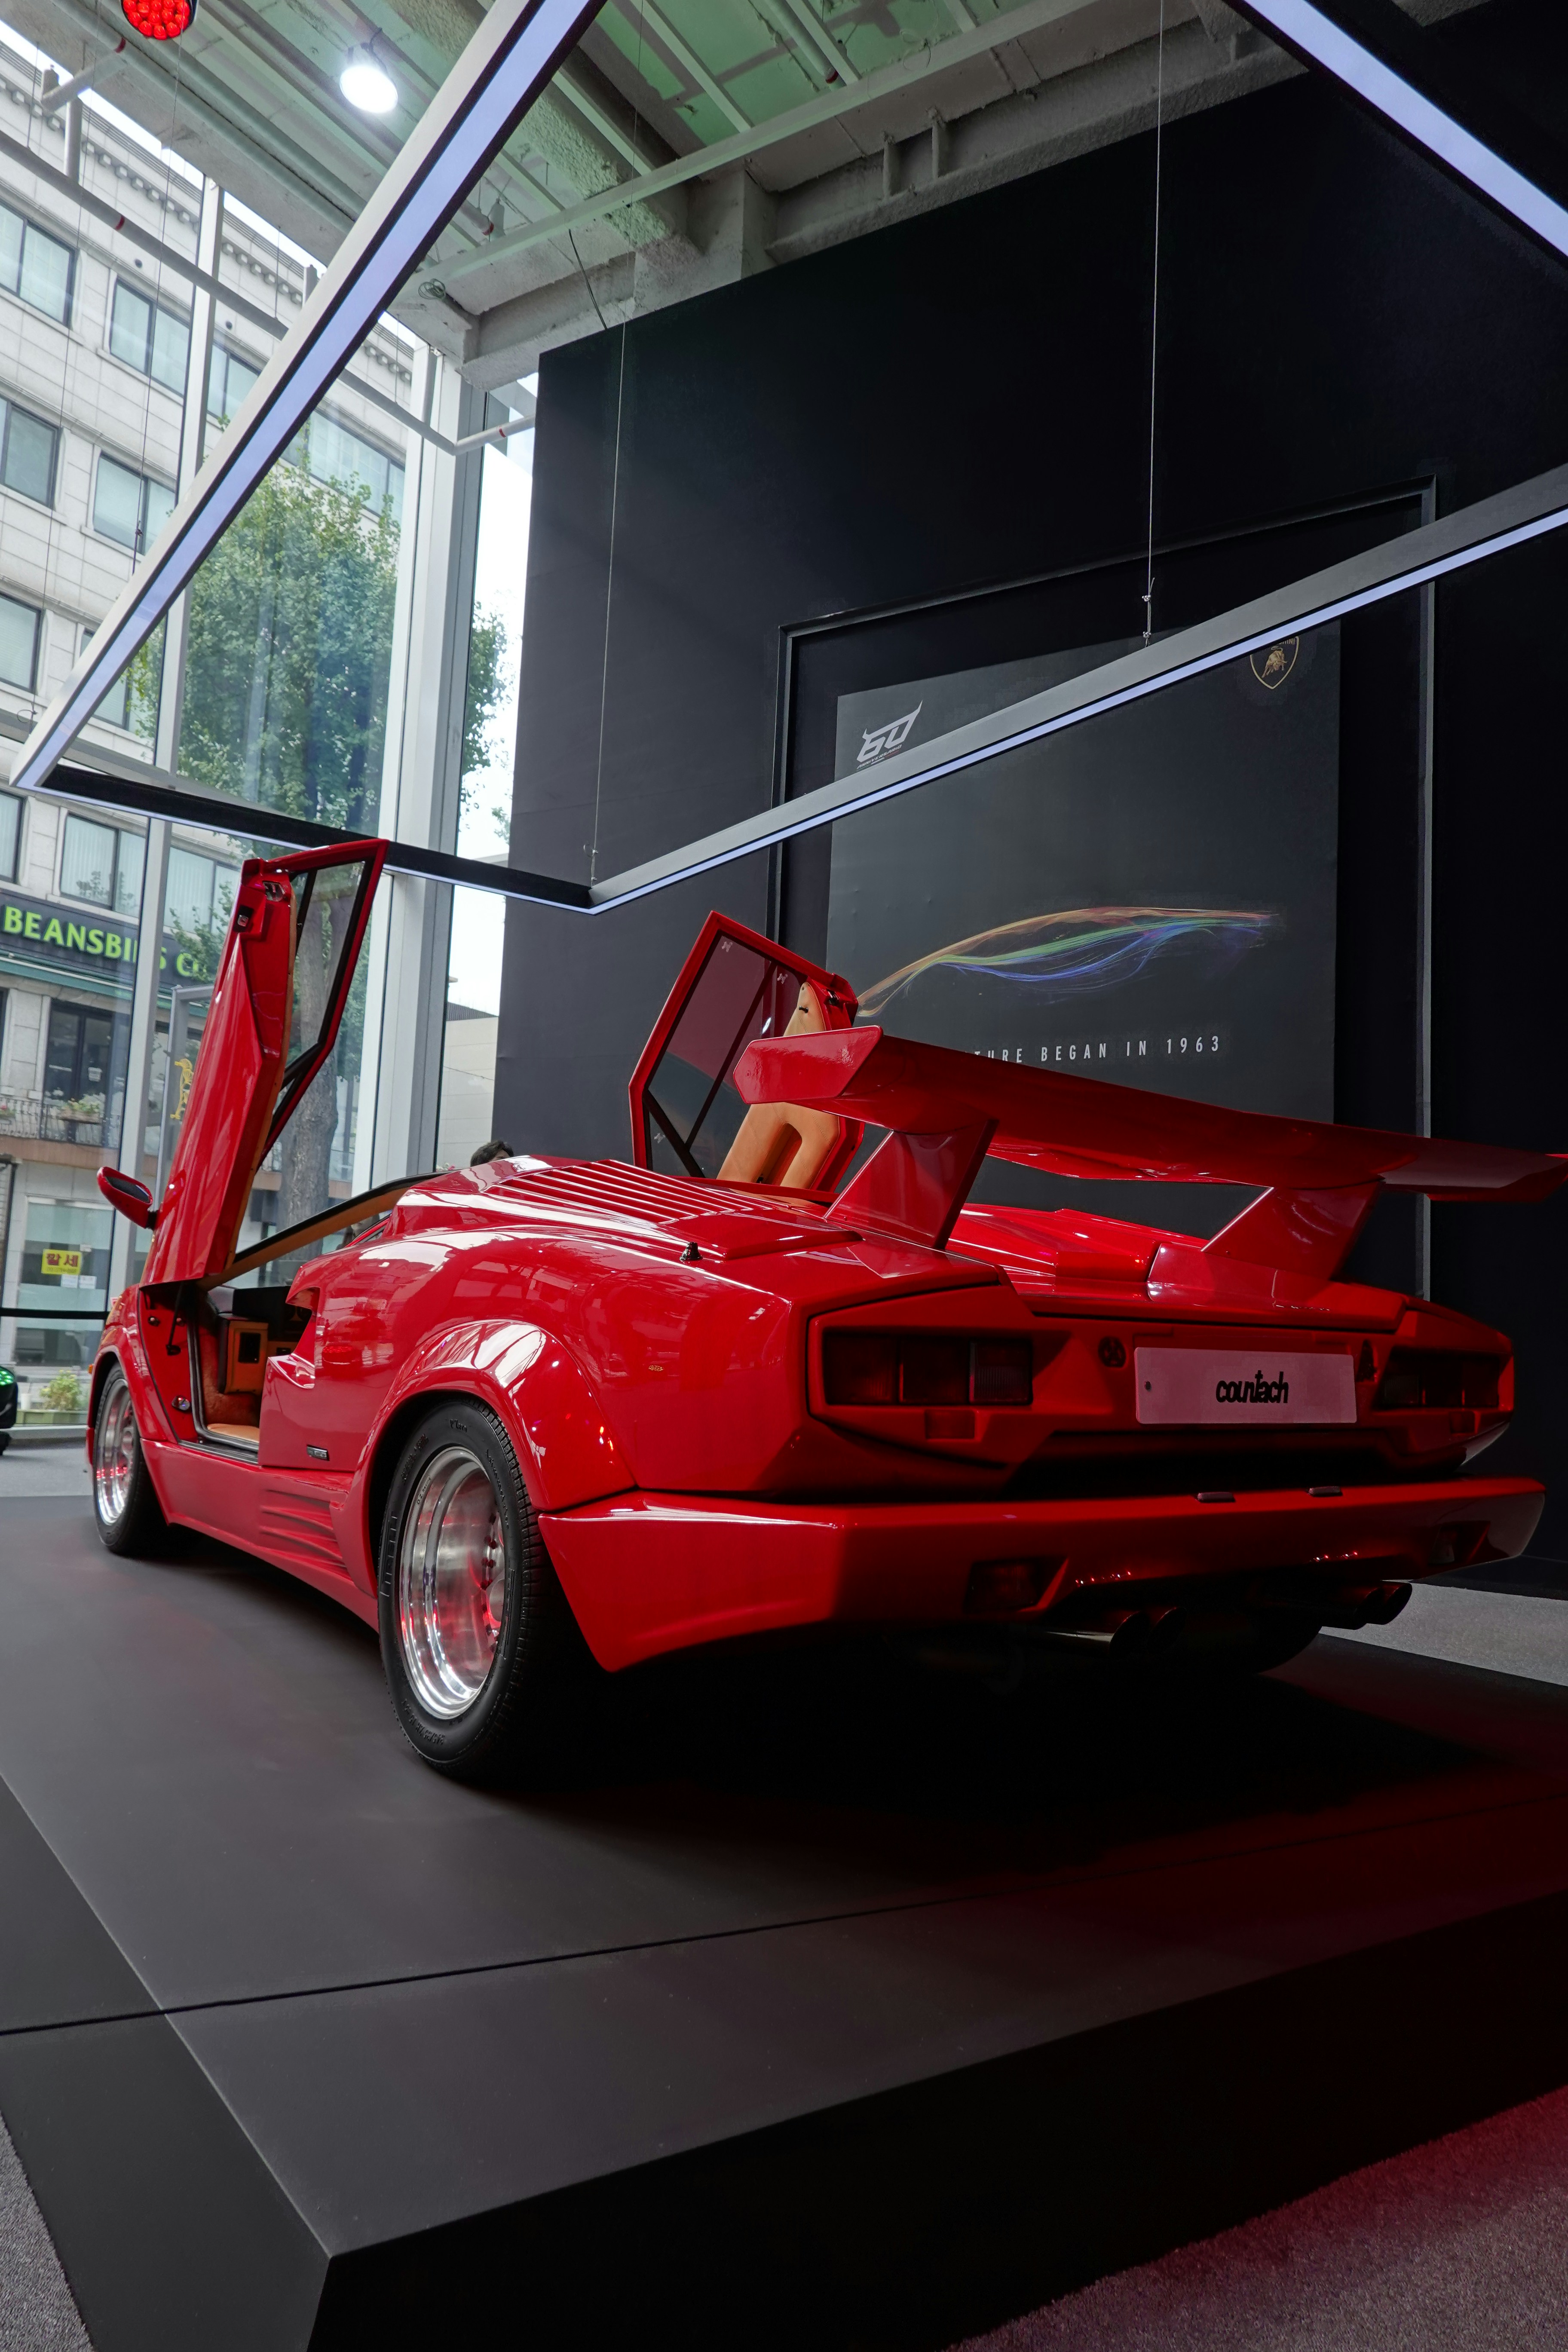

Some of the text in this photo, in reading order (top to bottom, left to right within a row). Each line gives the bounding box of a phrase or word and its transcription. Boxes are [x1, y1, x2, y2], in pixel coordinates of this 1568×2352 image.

[857, 700, 923, 763] 60
[3, 905, 167, 970] BEANSBI
[1041, 1043, 1107, 1062] BEGAN
[1127, 1040, 1146, 1057] IN
[1167, 1035, 1219, 1054] 1963
[1215, 1369, 1289, 1404] countach
